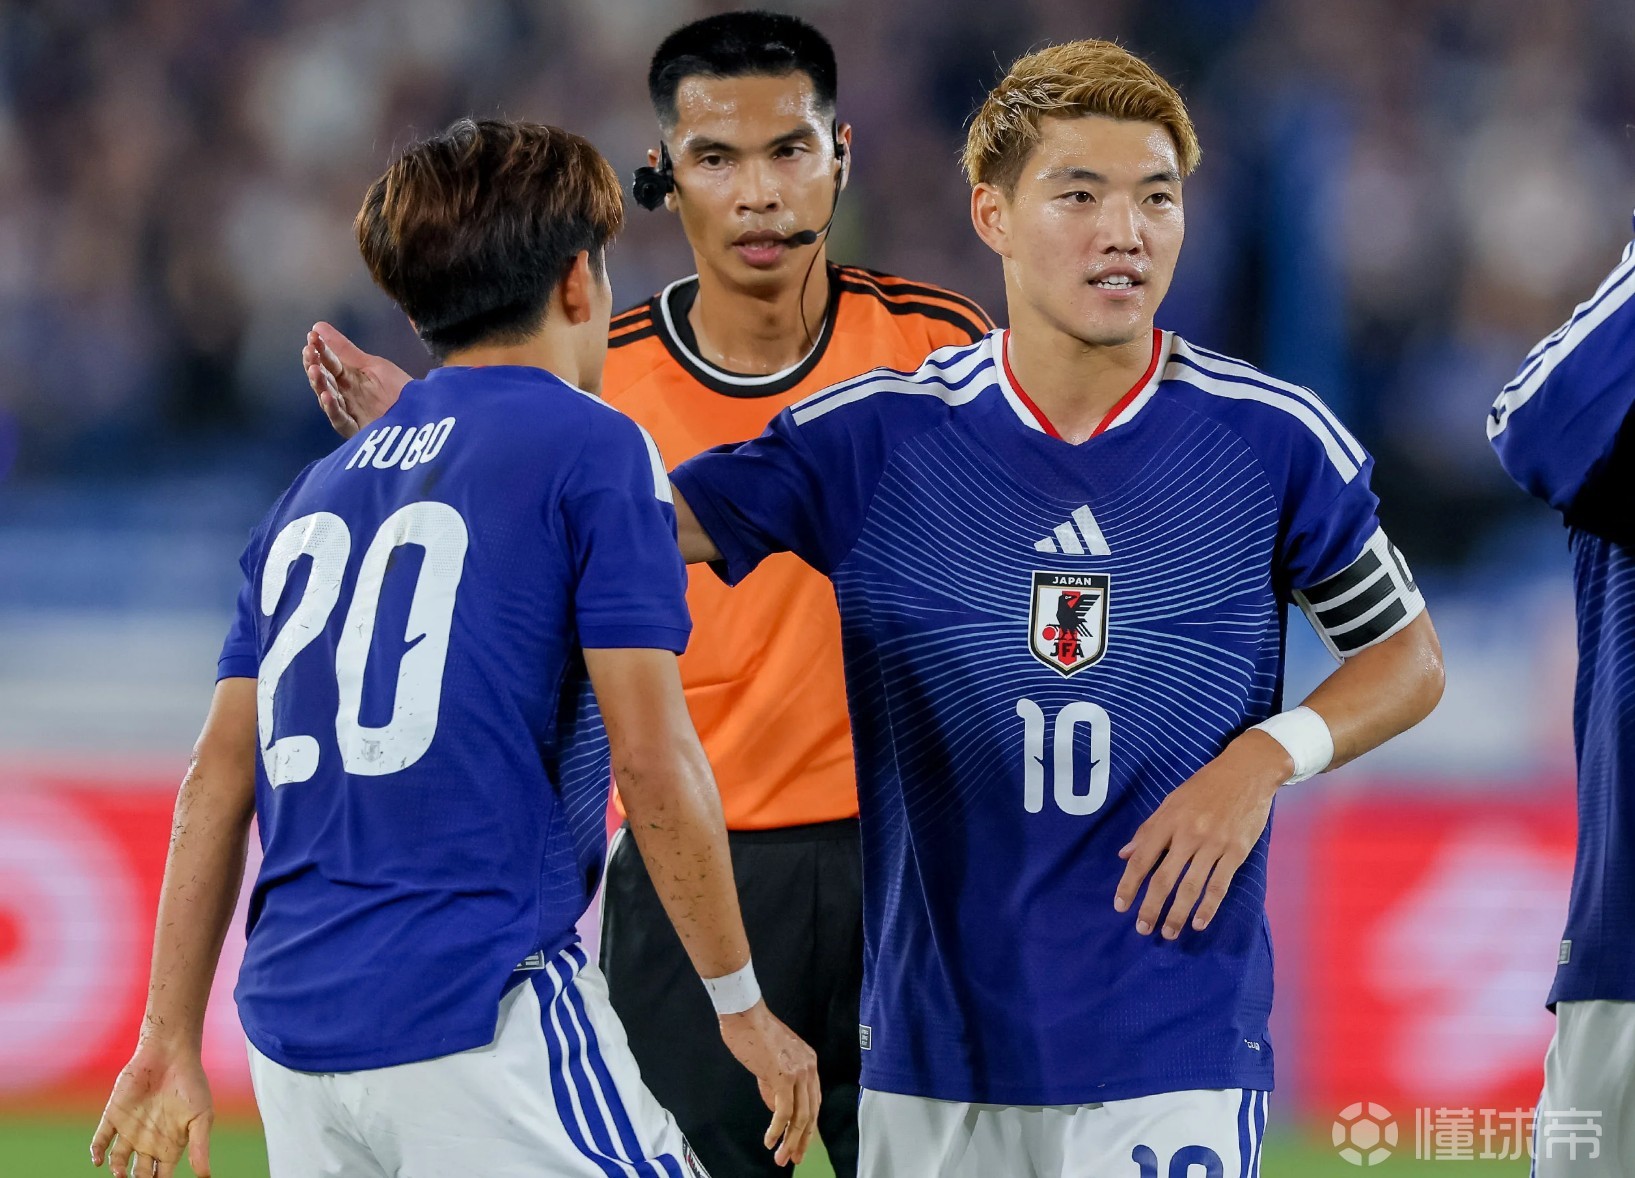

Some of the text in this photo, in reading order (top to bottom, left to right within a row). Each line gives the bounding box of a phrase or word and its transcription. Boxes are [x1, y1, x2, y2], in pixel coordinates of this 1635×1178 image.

[345, 416, 456, 471] KUBO
[1052, 576, 1092, 586] JAPAN
[256, 500, 469, 790] 20
[1050, 642, 1085, 659] JFA
[1015, 698, 1111, 816] 10
